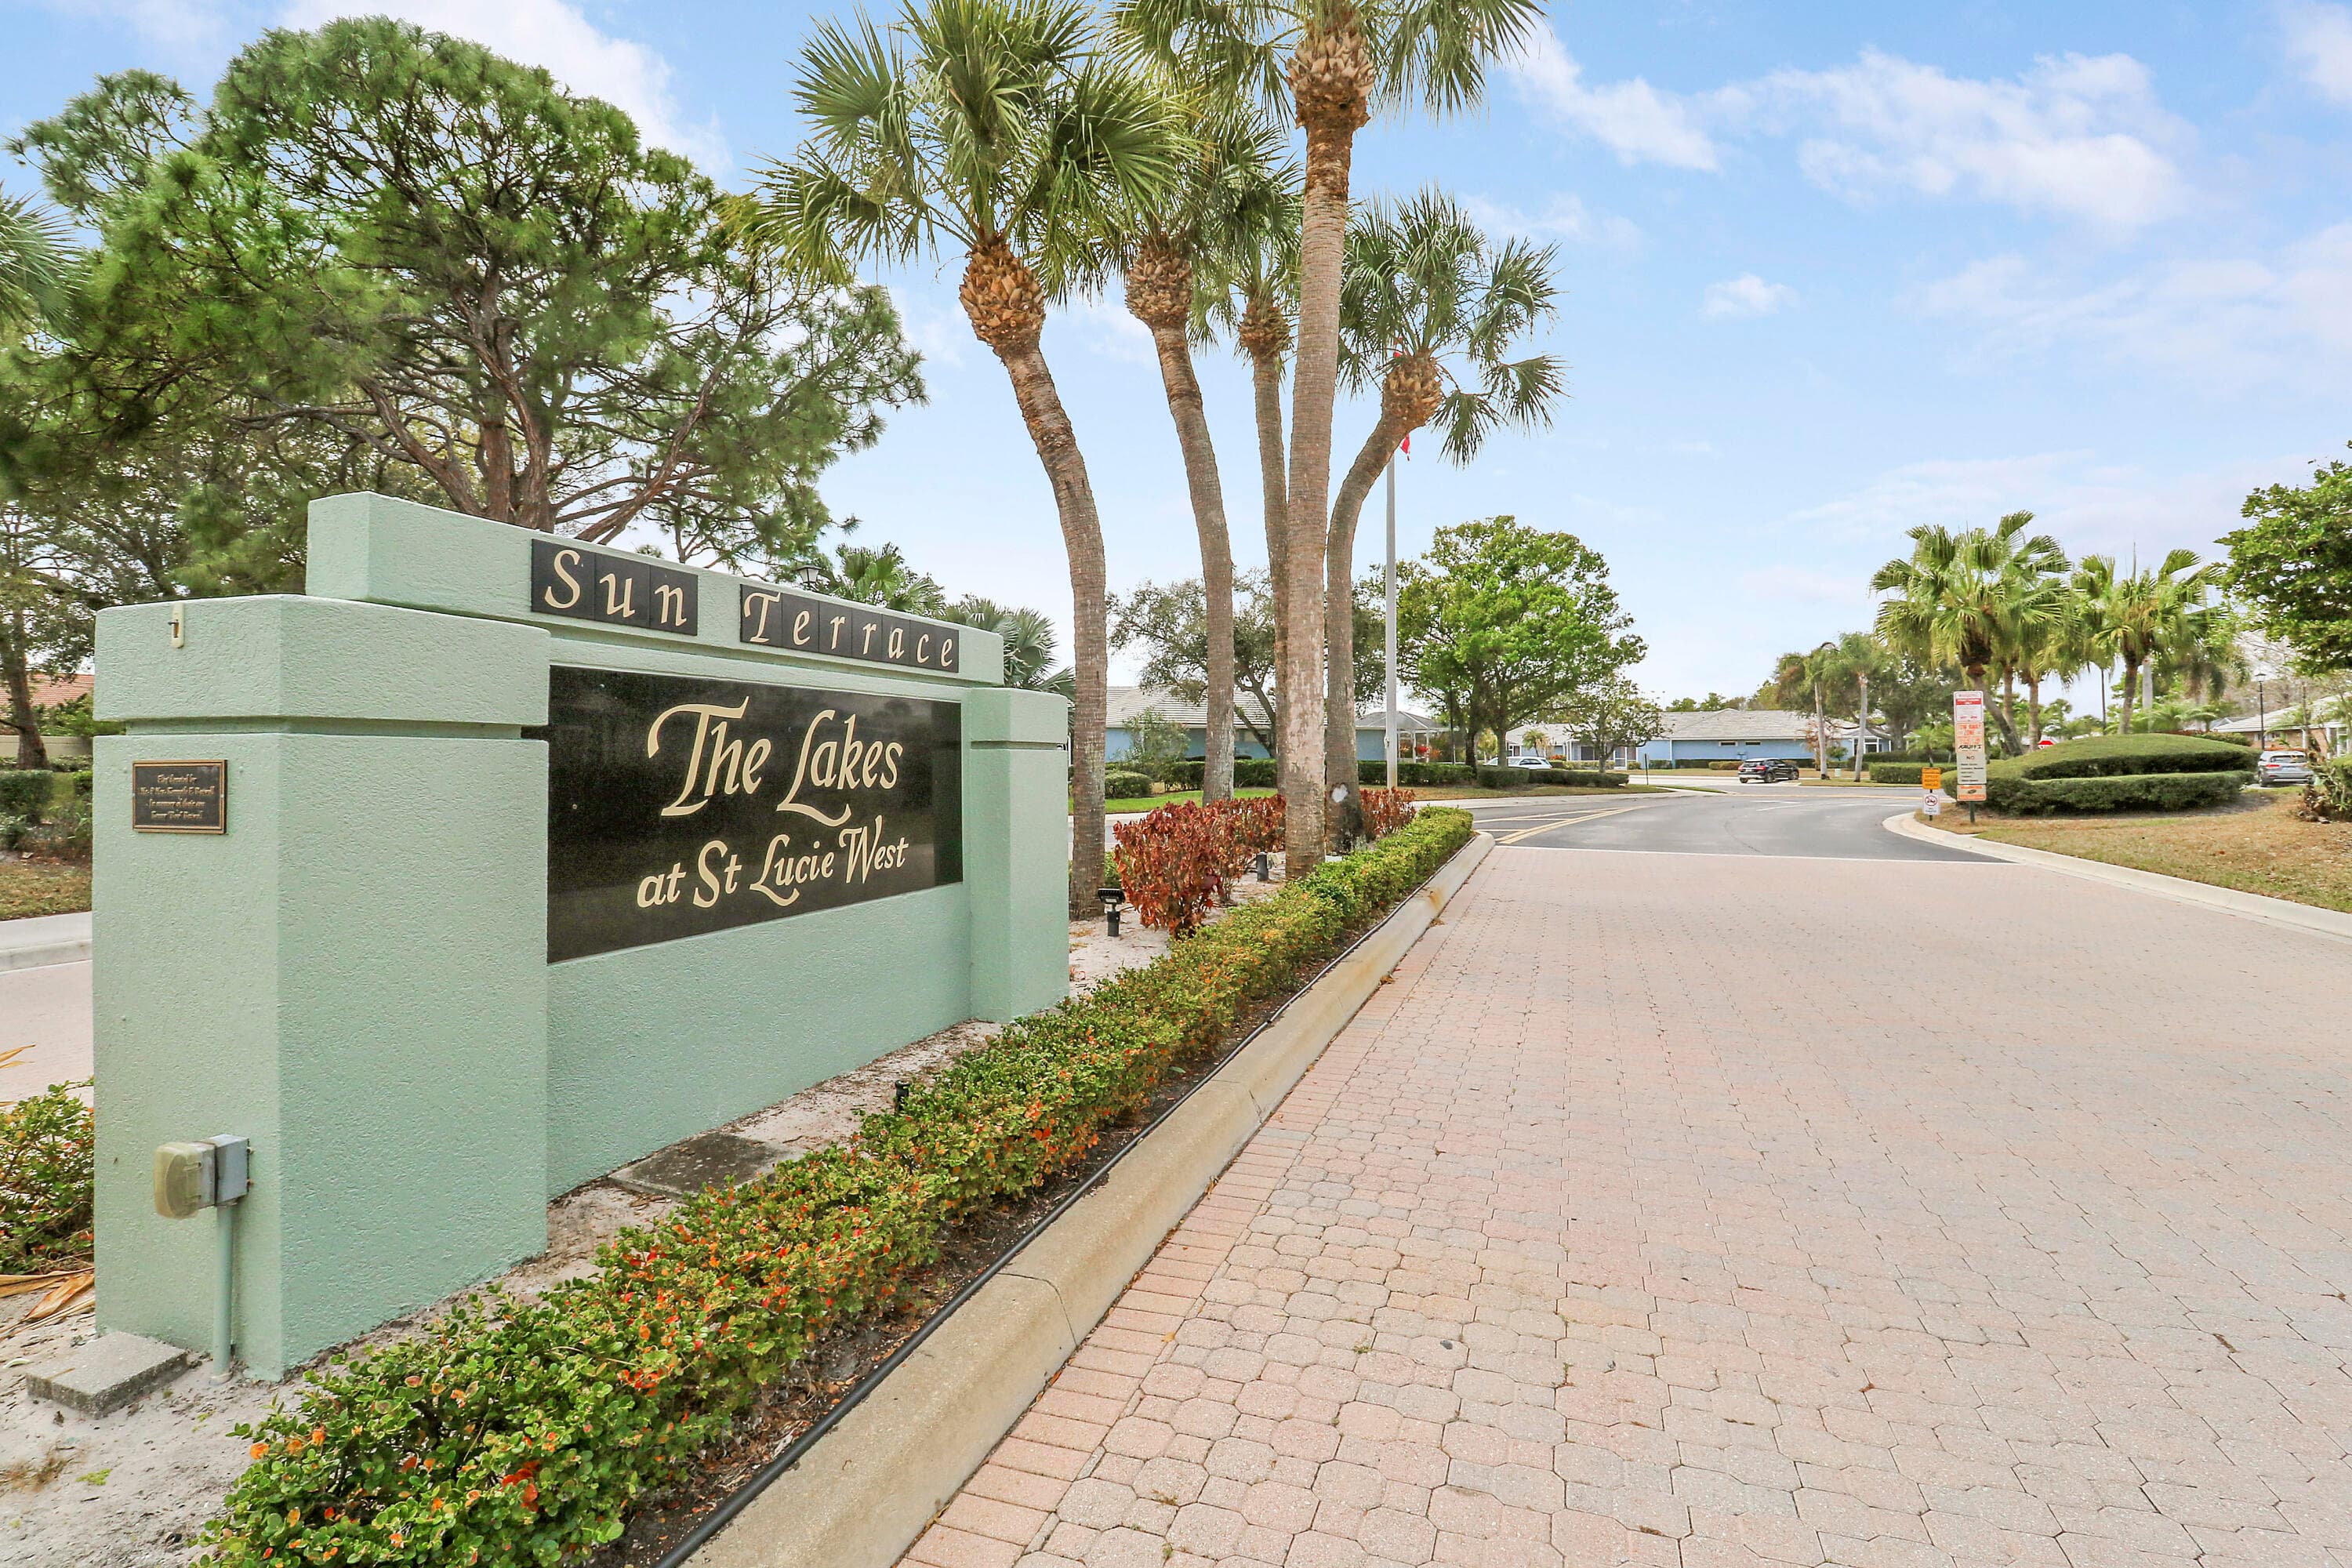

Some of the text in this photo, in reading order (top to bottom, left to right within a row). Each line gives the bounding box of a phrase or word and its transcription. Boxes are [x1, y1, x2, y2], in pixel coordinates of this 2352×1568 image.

[544, 549, 954, 668] Sun Terrace
[647, 695, 904, 827] The Lakes
[637, 815, 909, 908] at St Lucie West
